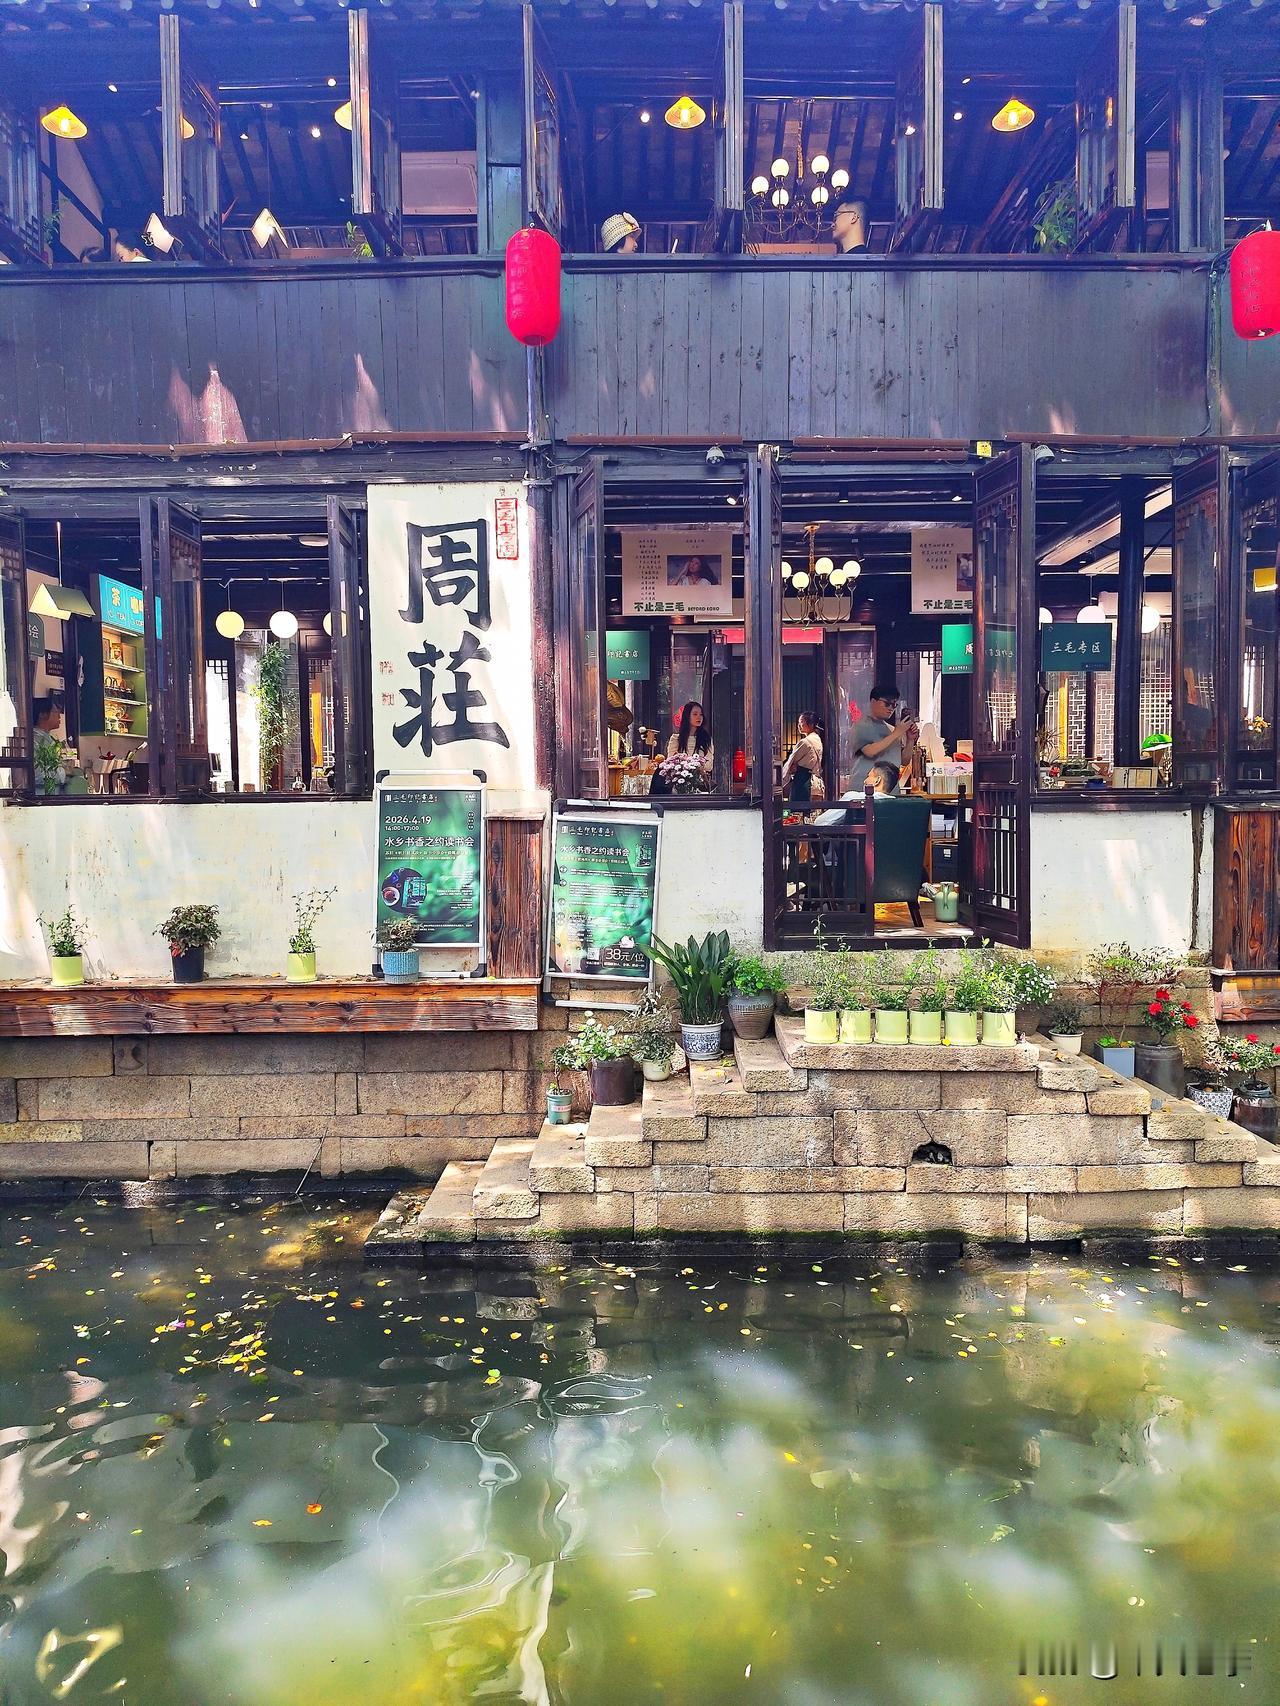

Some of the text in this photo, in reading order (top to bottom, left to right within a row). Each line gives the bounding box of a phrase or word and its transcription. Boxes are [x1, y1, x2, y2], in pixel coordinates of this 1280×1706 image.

[634, 601, 685, 612] 不止是三毛
[1051, 640, 1101, 654] 三毛专区
[385, 815, 432, 825] 2026.4.19
[384, 836, 475, 847] 水乡书香之约读书会
[560, 845, 630, 857] 水乡书香之约读书会
[605, 948, 645, 962] 38元/位
